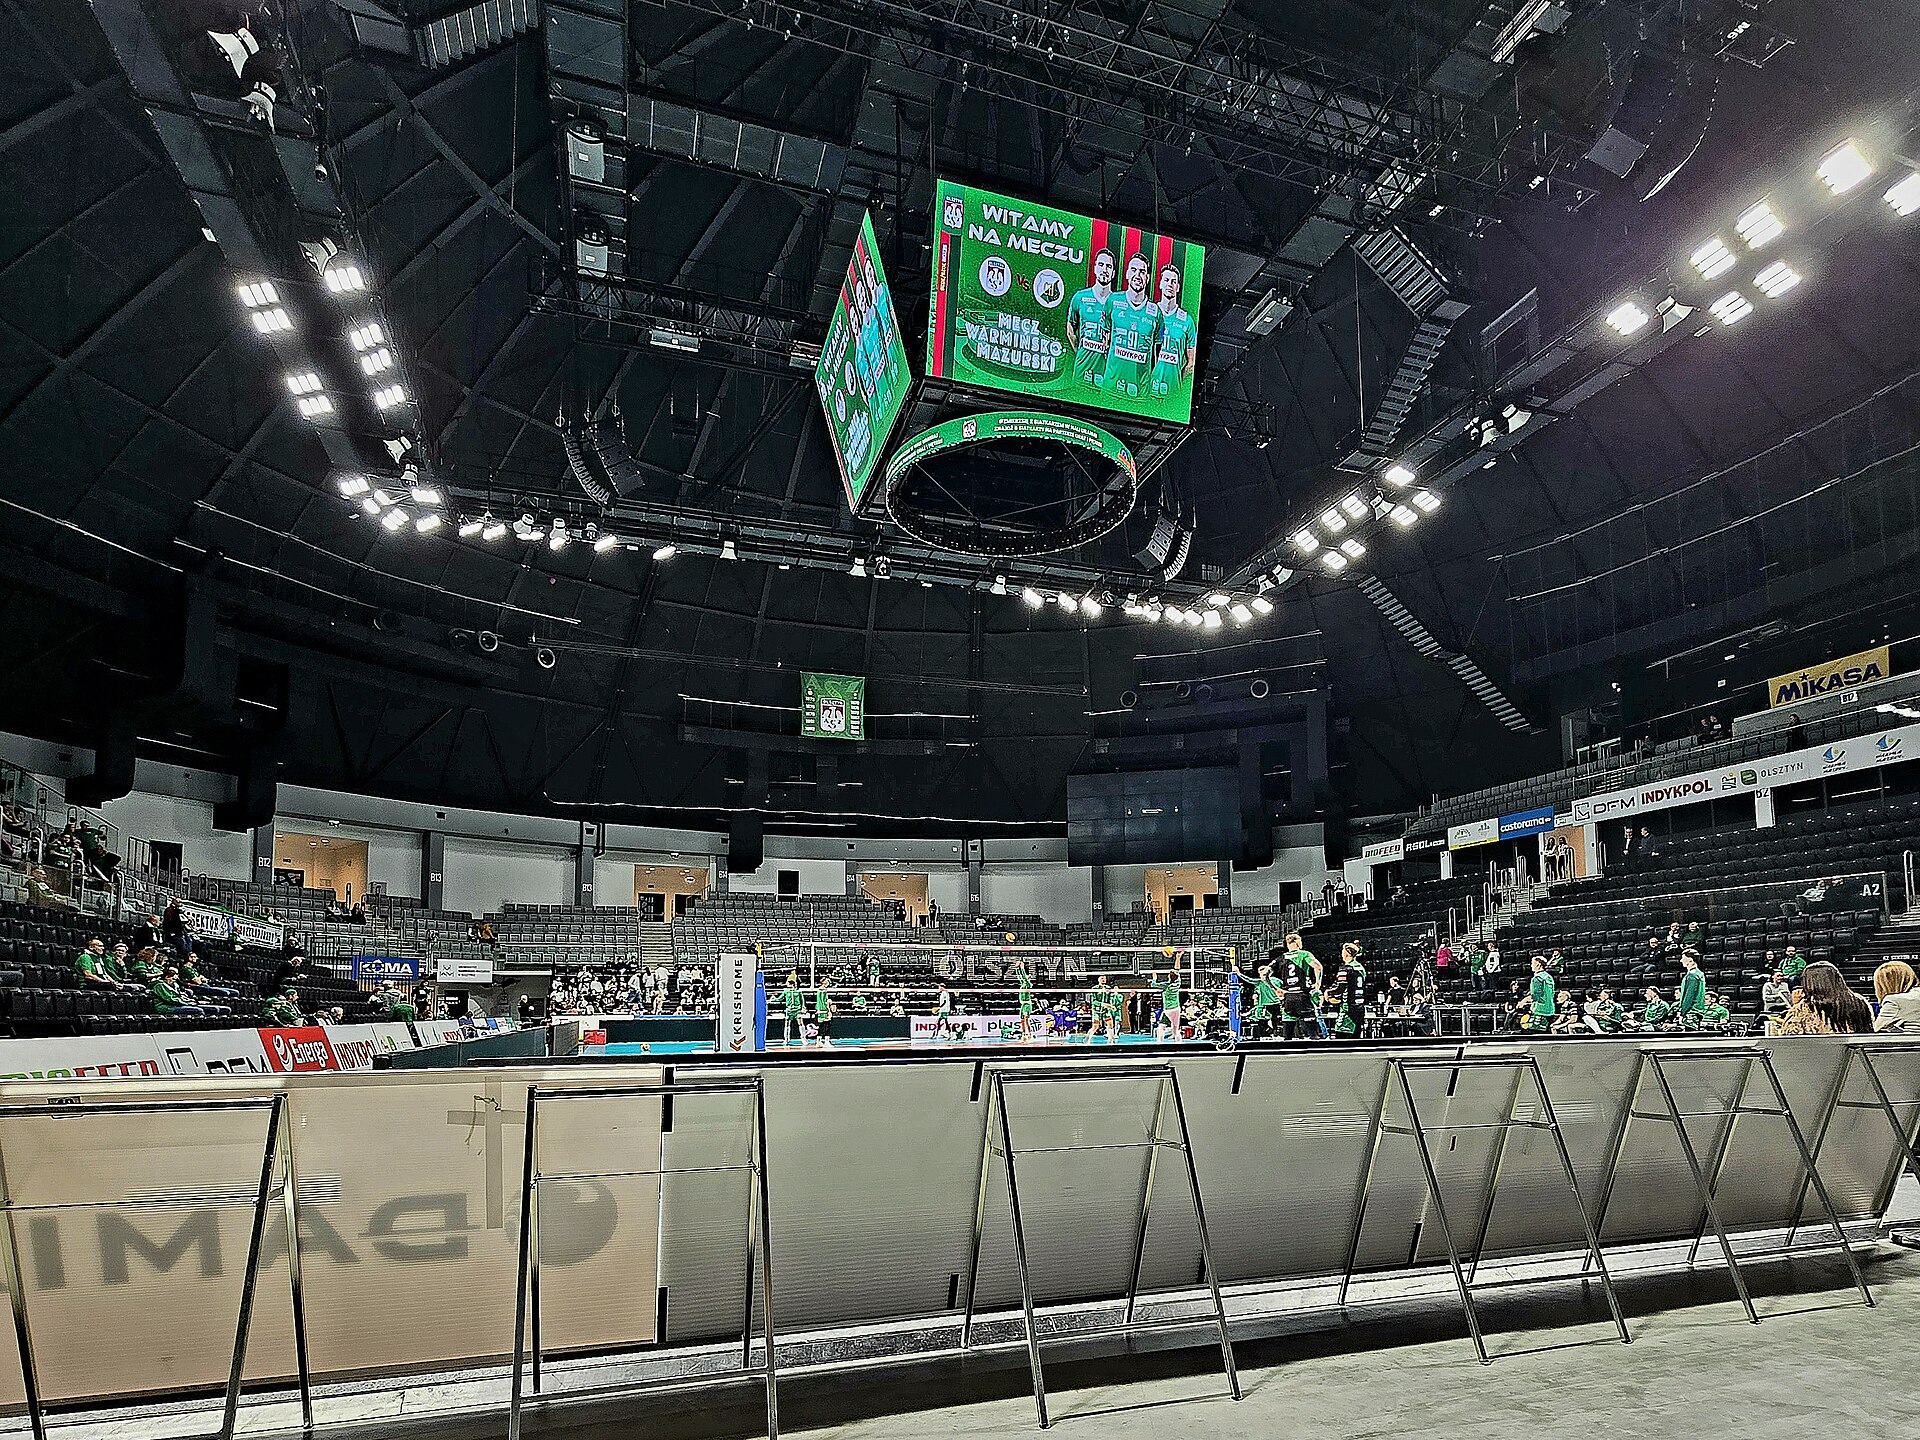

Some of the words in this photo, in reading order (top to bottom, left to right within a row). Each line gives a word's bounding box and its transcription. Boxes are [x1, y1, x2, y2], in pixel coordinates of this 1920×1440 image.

[982, 203, 1074, 240] WITAMY
[968, 223, 1002, 246] NA
[1006, 233, 1084, 265] MECZU
[998, 312, 1040, 334] MECZ
[976, 343, 1055, 373] MAZURSKI
[1776, 662, 1883, 705] MIKASA
[1760, 762, 1804, 778] OLSZTYN
[1641, 779, 1713, 805] INDYKPOL
[1593, 796, 1636, 815] DFM
[1500, 816, 1545, 833] castorama
[258, 856, 271, 868] B12
[430, 872, 442, 882] B13
[1862, 884, 1880, 896] A2
[932, 952, 1087, 981] OLSZTYN
[1288, 964, 1296, 976] 2
[733, 959, 743, 1035] KRISHOME
[288, 1038, 329, 1068] Energa
